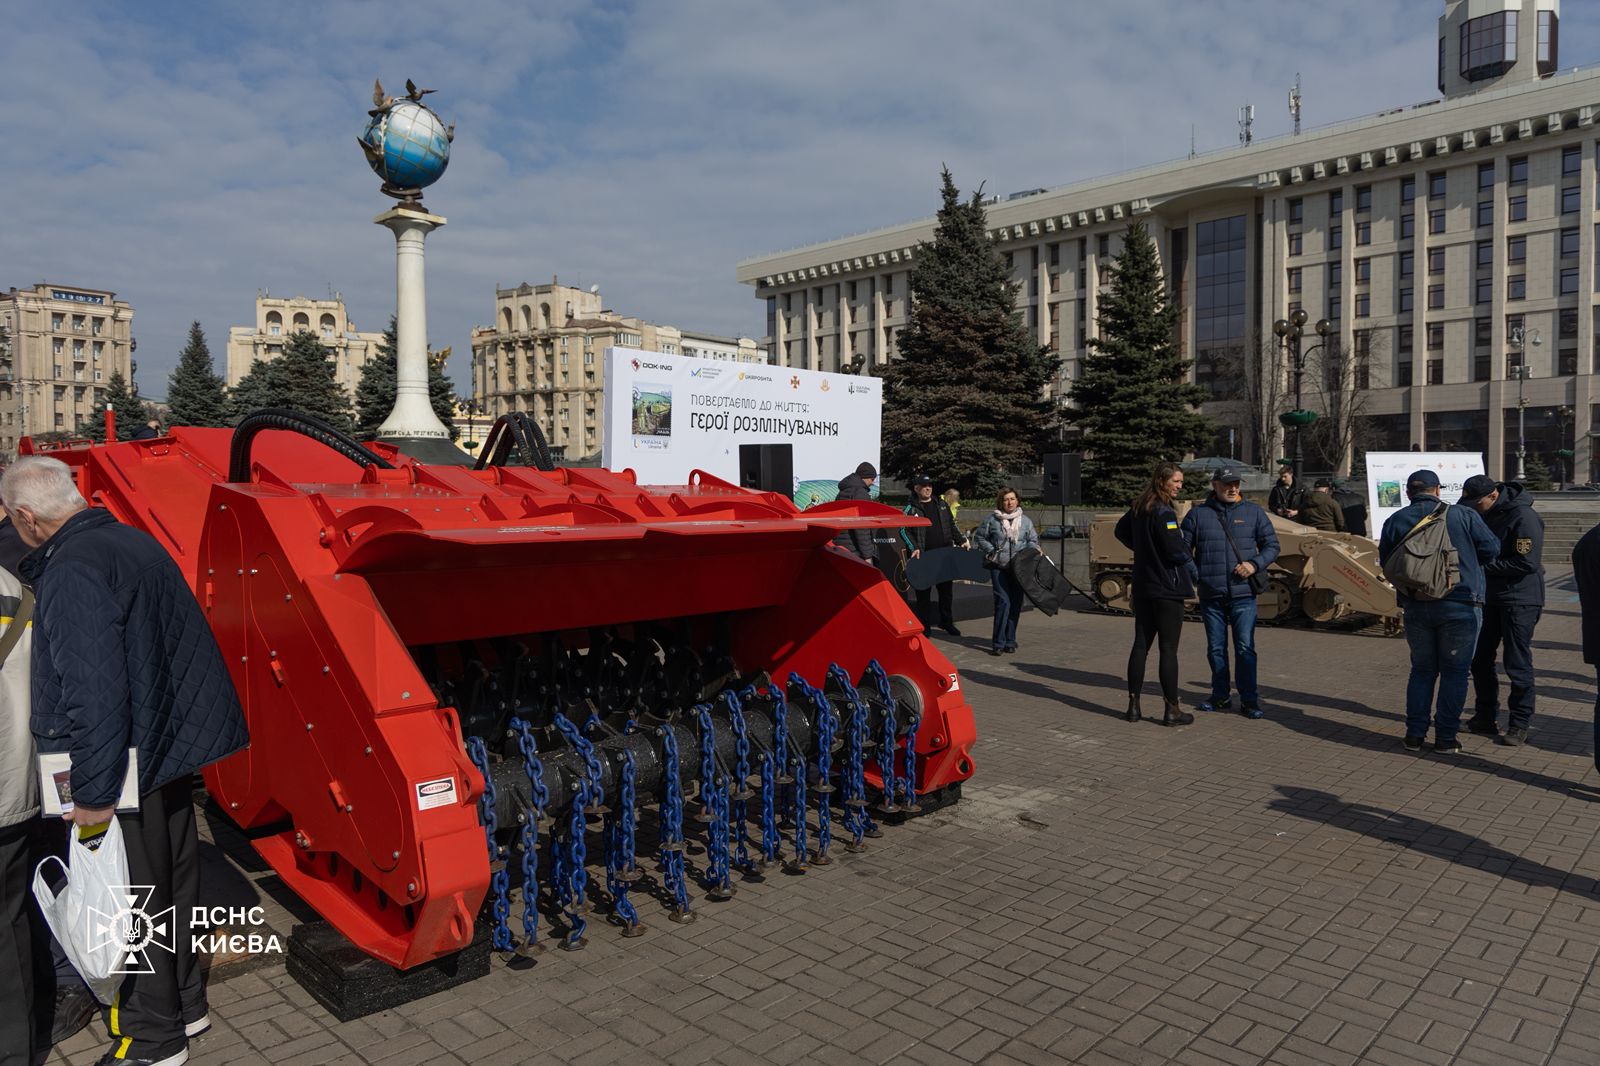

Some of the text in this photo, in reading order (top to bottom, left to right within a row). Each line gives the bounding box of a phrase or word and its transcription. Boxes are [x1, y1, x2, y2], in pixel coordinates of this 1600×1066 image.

[690, 394, 810, 413] ПОВЕРТАЄМО ДО ЖИТТЯ:
[690, 411, 839, 437] ГЕРОЇ РОЗМІНУВАННЯ
